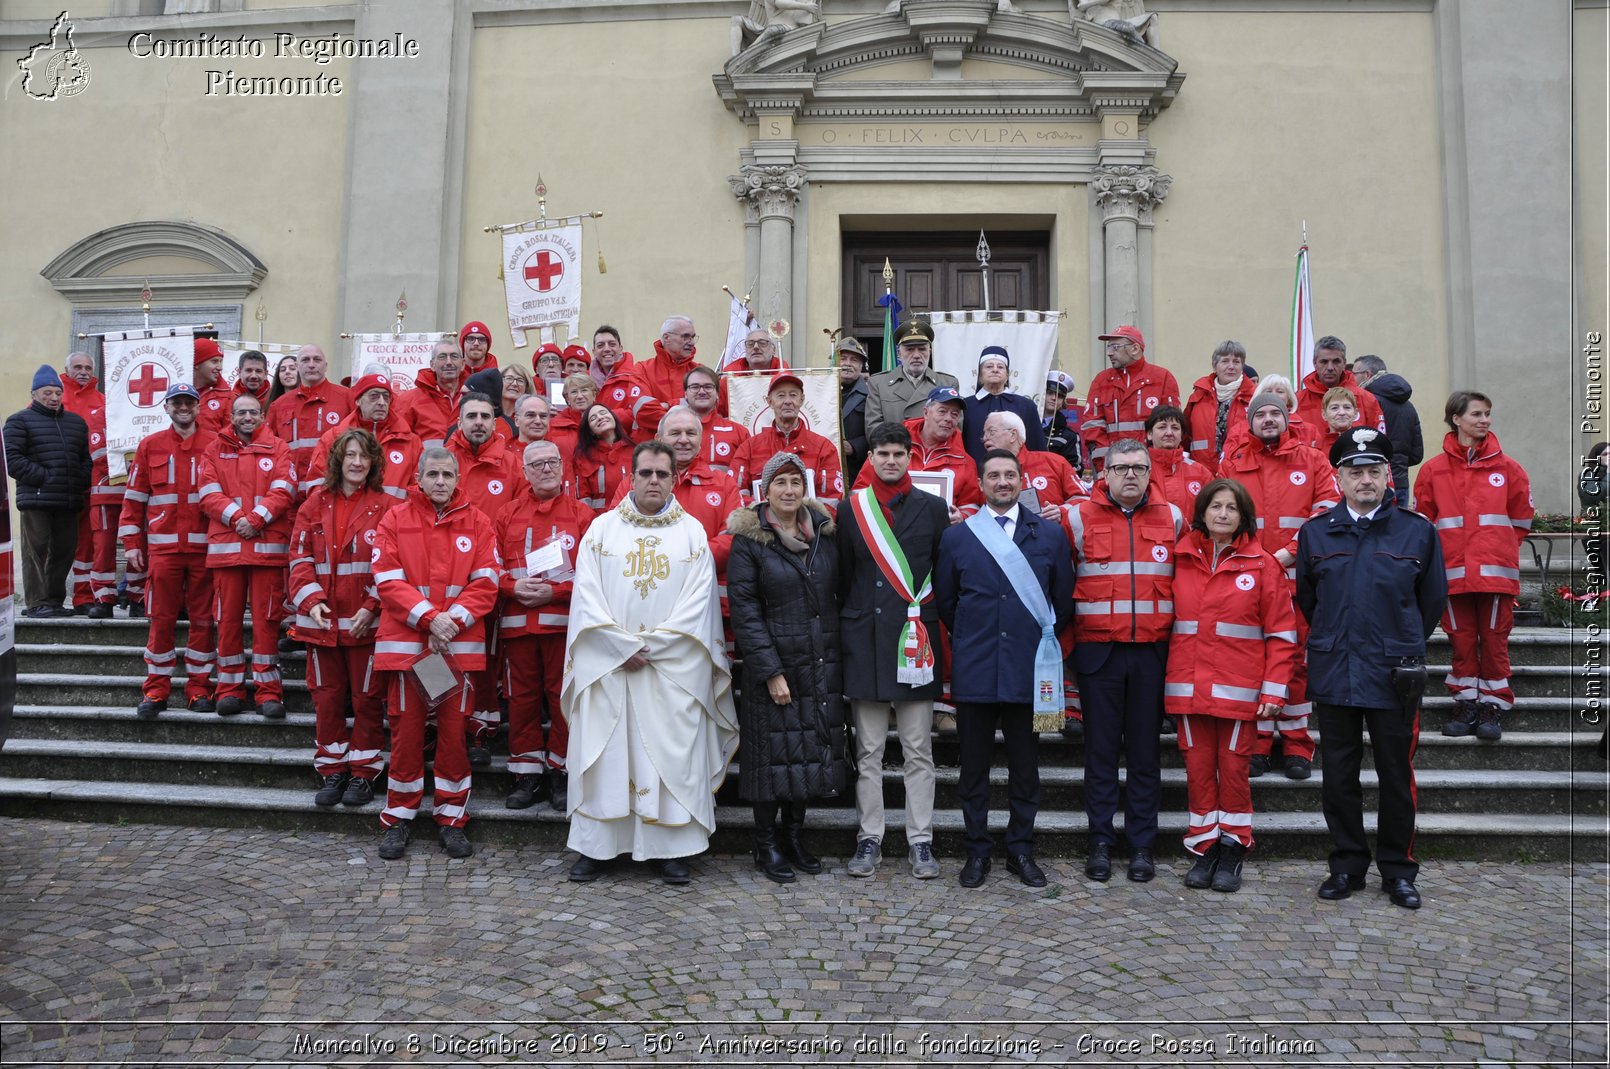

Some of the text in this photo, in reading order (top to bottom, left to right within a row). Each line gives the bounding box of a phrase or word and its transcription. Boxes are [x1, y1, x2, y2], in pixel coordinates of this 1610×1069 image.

[770, 121, 782, 137] S
[1113, 120, 1130, 137] Q
[821, 128, 1028, 144] O FELIX CVLPA
[509, 234, 576, 270] CROCE ROSSA ITALIANA
[522, 298, 550, 310] GRUPPO
[366, 344, 398, 353] CROCE
[111, 345, 184, 383] CROCE ROSSA ITALIANA
[377, 356, 423, 364] ITALIANA
[131, 415, 163, 426] GRUPPO
[142, 425, 150, 433] DI
